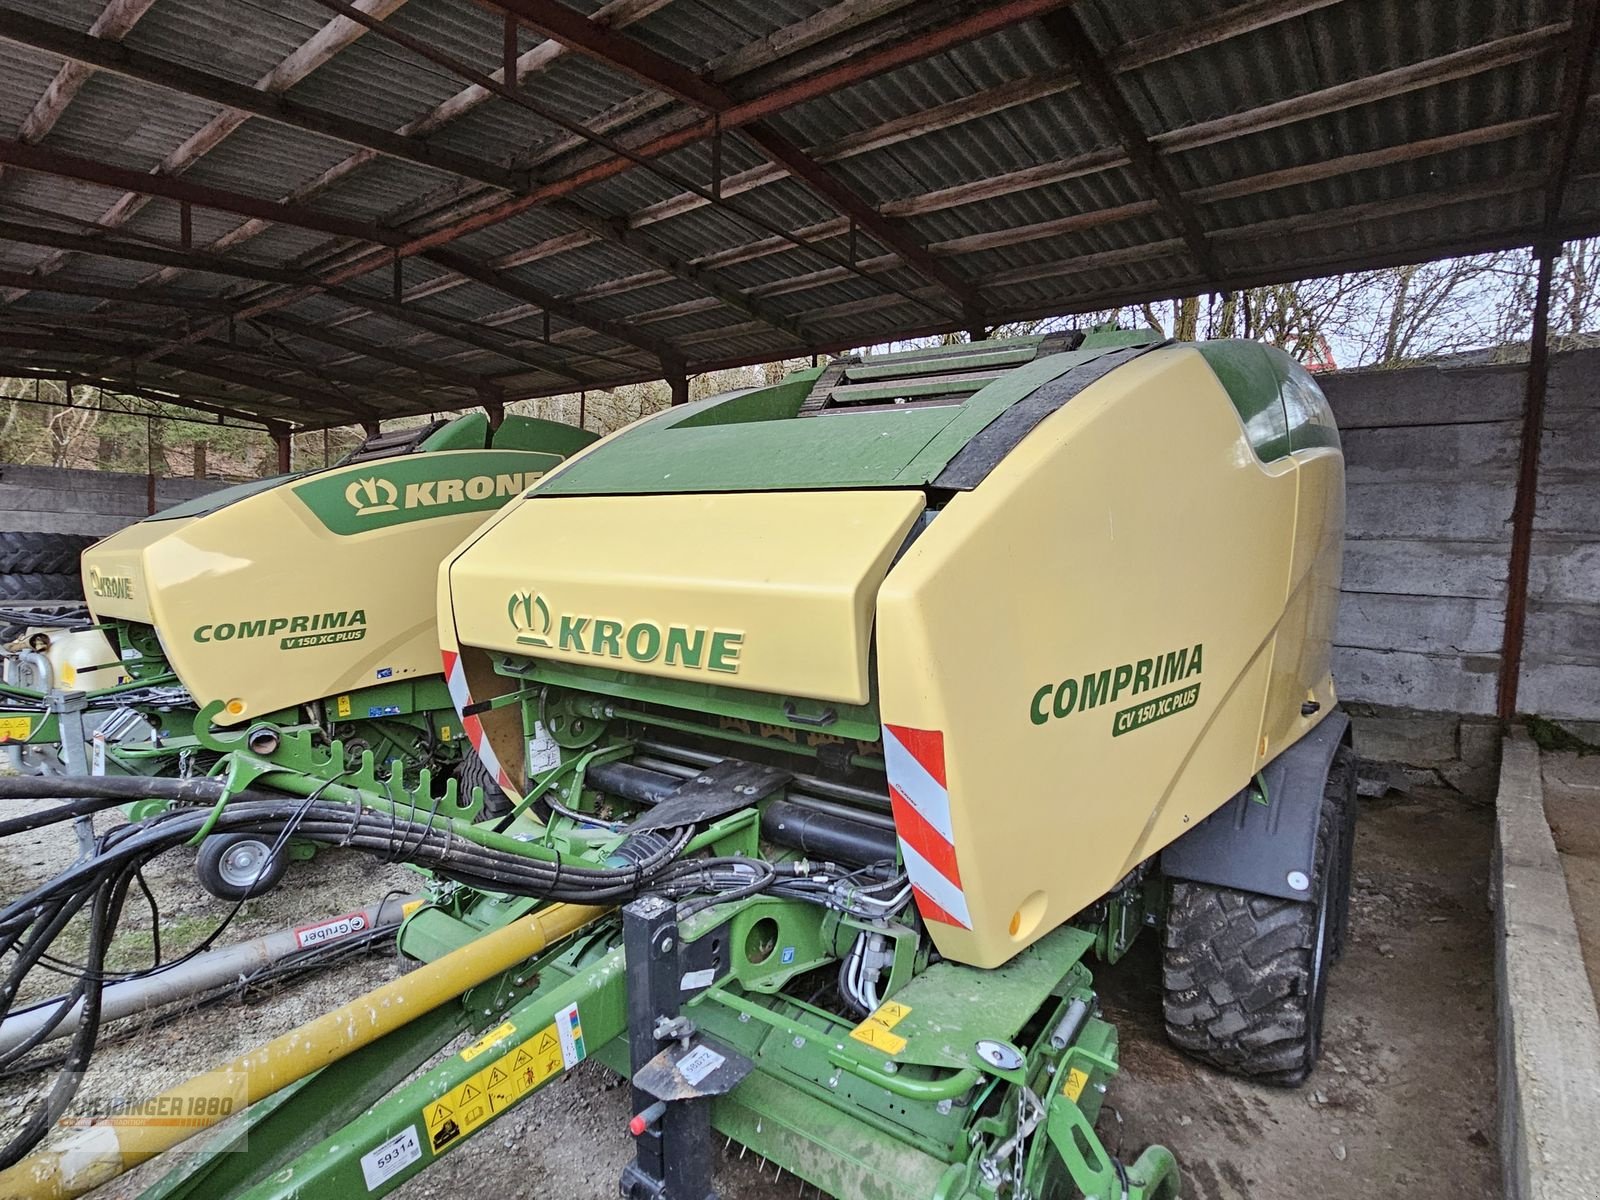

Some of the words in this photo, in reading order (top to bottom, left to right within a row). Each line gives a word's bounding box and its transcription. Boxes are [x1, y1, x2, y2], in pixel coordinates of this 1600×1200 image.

[100, 576, 133, 600] KRONE
[193, 609, 367, 643] COMPRIMA
[286, 639, 297, 648] V
[298, 637, 317, 647] 150
[318, 634, 334, 644] XC
[336, 630, 362, 642] PLUS
[558, 615, 745, 673] KRONE
[1030, 643, 1203, 726] COMPRIMA
[1118, 710, 1136, 731] CV
[1137, 704, 1156, 724] 150
[1156, 697, 1173, 716] XC
[1172, 688, 1197, 711] PLUS
[303, 923, 349, 943] Gruber
[377, 1138, 414, 1168] 59314
